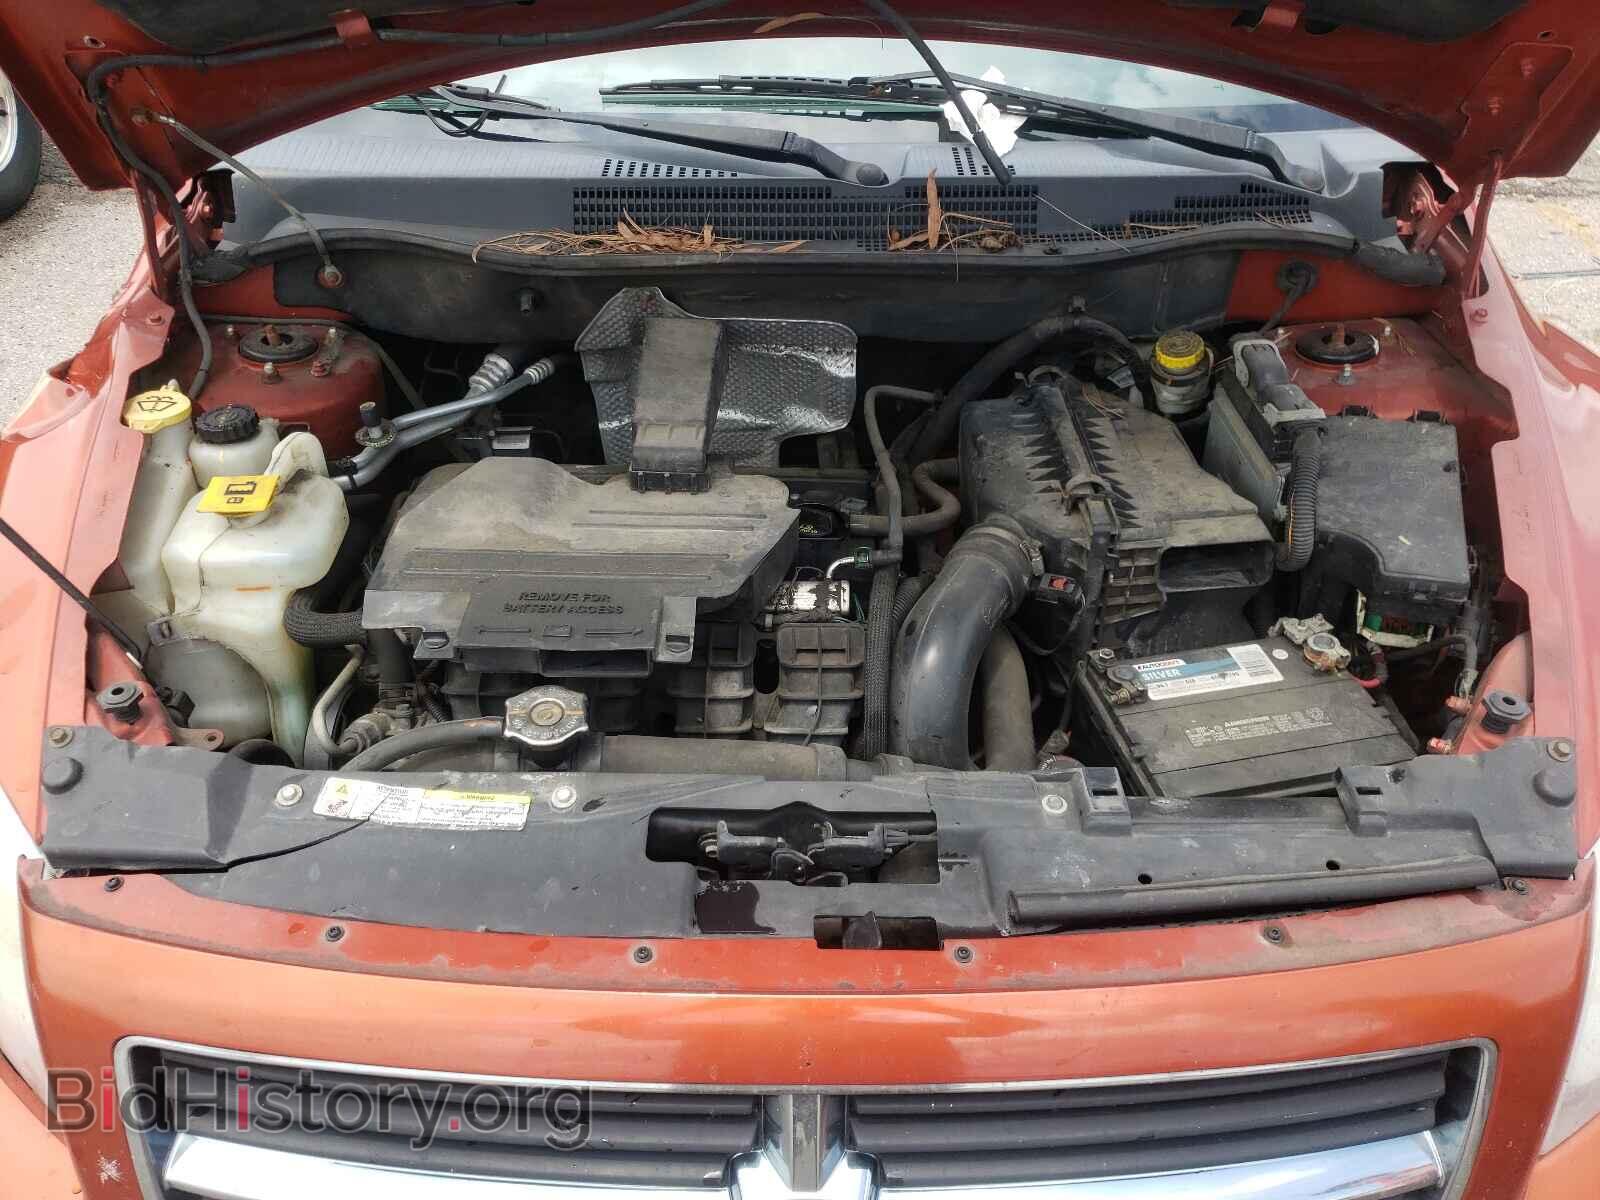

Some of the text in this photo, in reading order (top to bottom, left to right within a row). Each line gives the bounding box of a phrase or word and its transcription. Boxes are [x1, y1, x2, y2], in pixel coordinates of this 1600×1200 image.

[518, 591, 611, 602] REMOVE FOR
[502, 602, 624, 615] BATTERY ACCESS
[1142, 668, 1182, 681] SILVER
